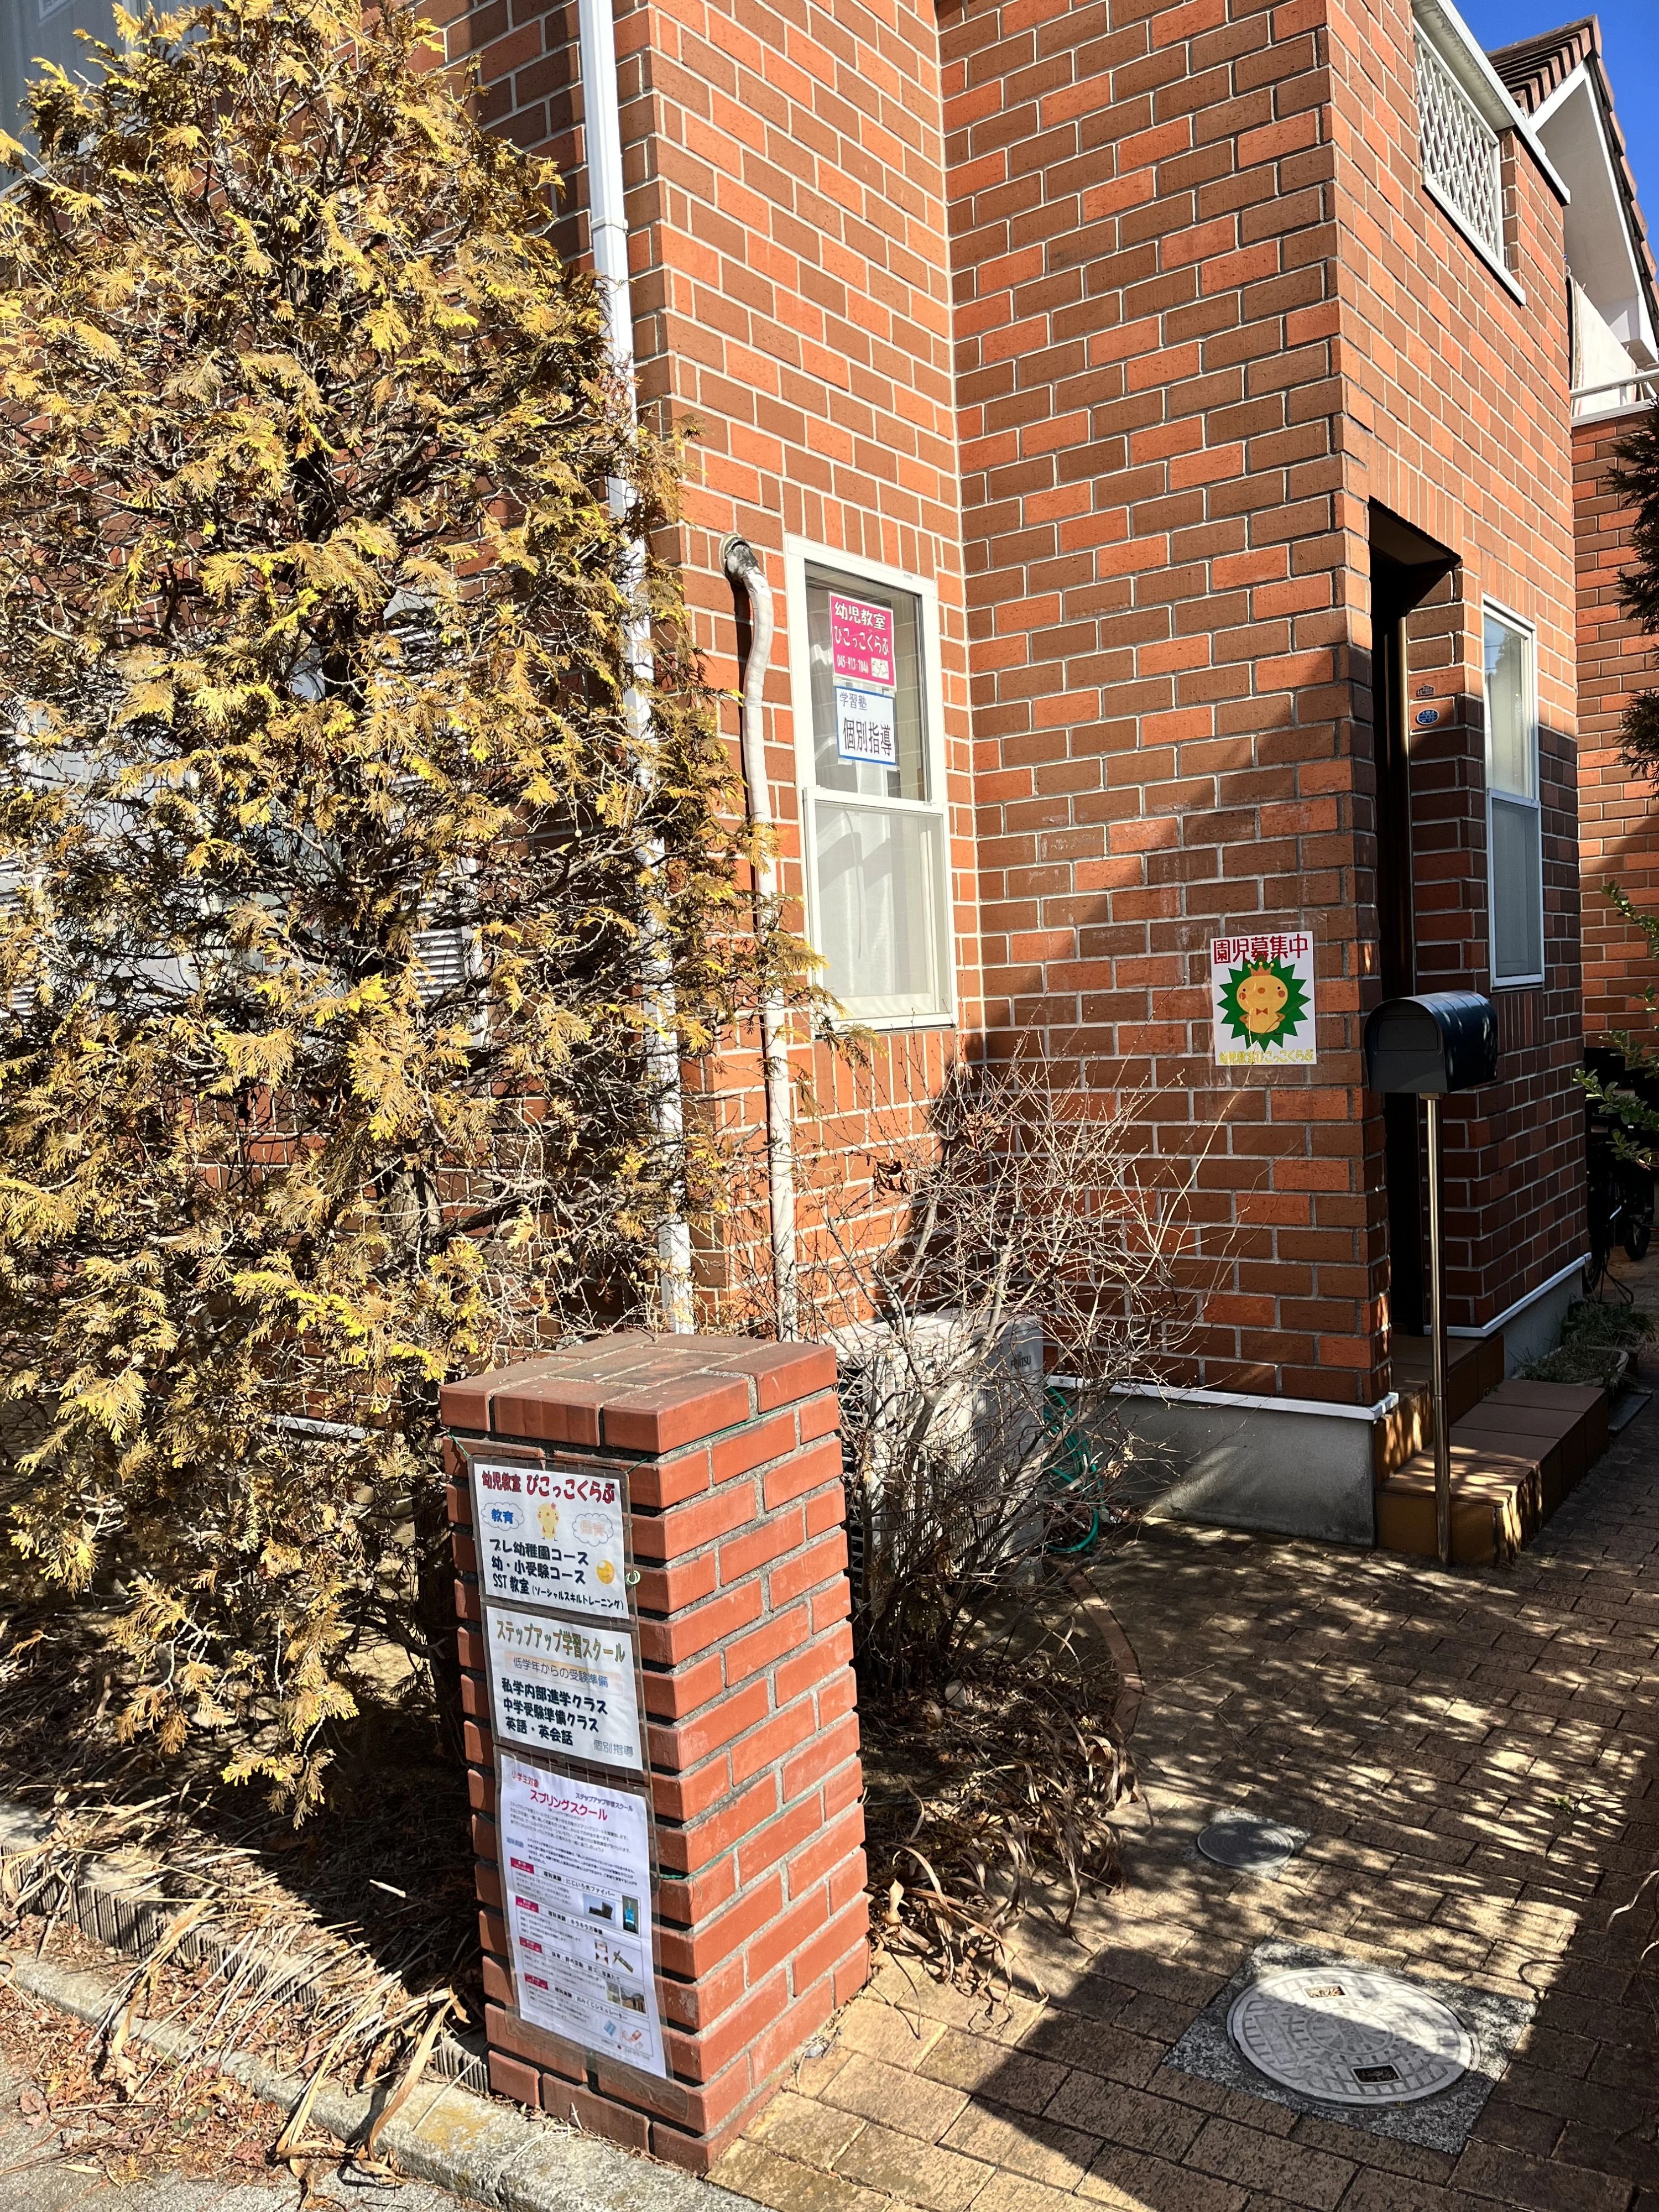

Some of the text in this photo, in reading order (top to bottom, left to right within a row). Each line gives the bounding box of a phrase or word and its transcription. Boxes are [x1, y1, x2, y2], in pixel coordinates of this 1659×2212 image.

[834, 601, 886, 631] 幼児教室
[839, 692, 868, 711] 学習塾
[843, 717, 892, 757] 個別指導
[1214, 933, 1308, 964] 園児募集中
[482, 1470, 521, 1493] 幼児教室
[491, 1508, 514, 1525] 教育
[489, 1538, 589, 1566] プレ幼稚園コース
[491, 1556, 586, 1585] 幼・小受験コース
[497, 1619, 625, 1663] ステップアップ学習スクール
[513, 1656, 608, 1688] 低学年からの受験準備
[502, 1677, 608, 1715] 私学内部進学クラス
[504, 1697, 599, 1732] 中学受験準備クラス
[505, 1716, 573, 1746] 英語・英会話
[593, 1740, 634, 1757] 個別指導
[511, 1770, 539, 1788] 小学生対象
[530, 1790, 608, 1820] スプリングスクール
